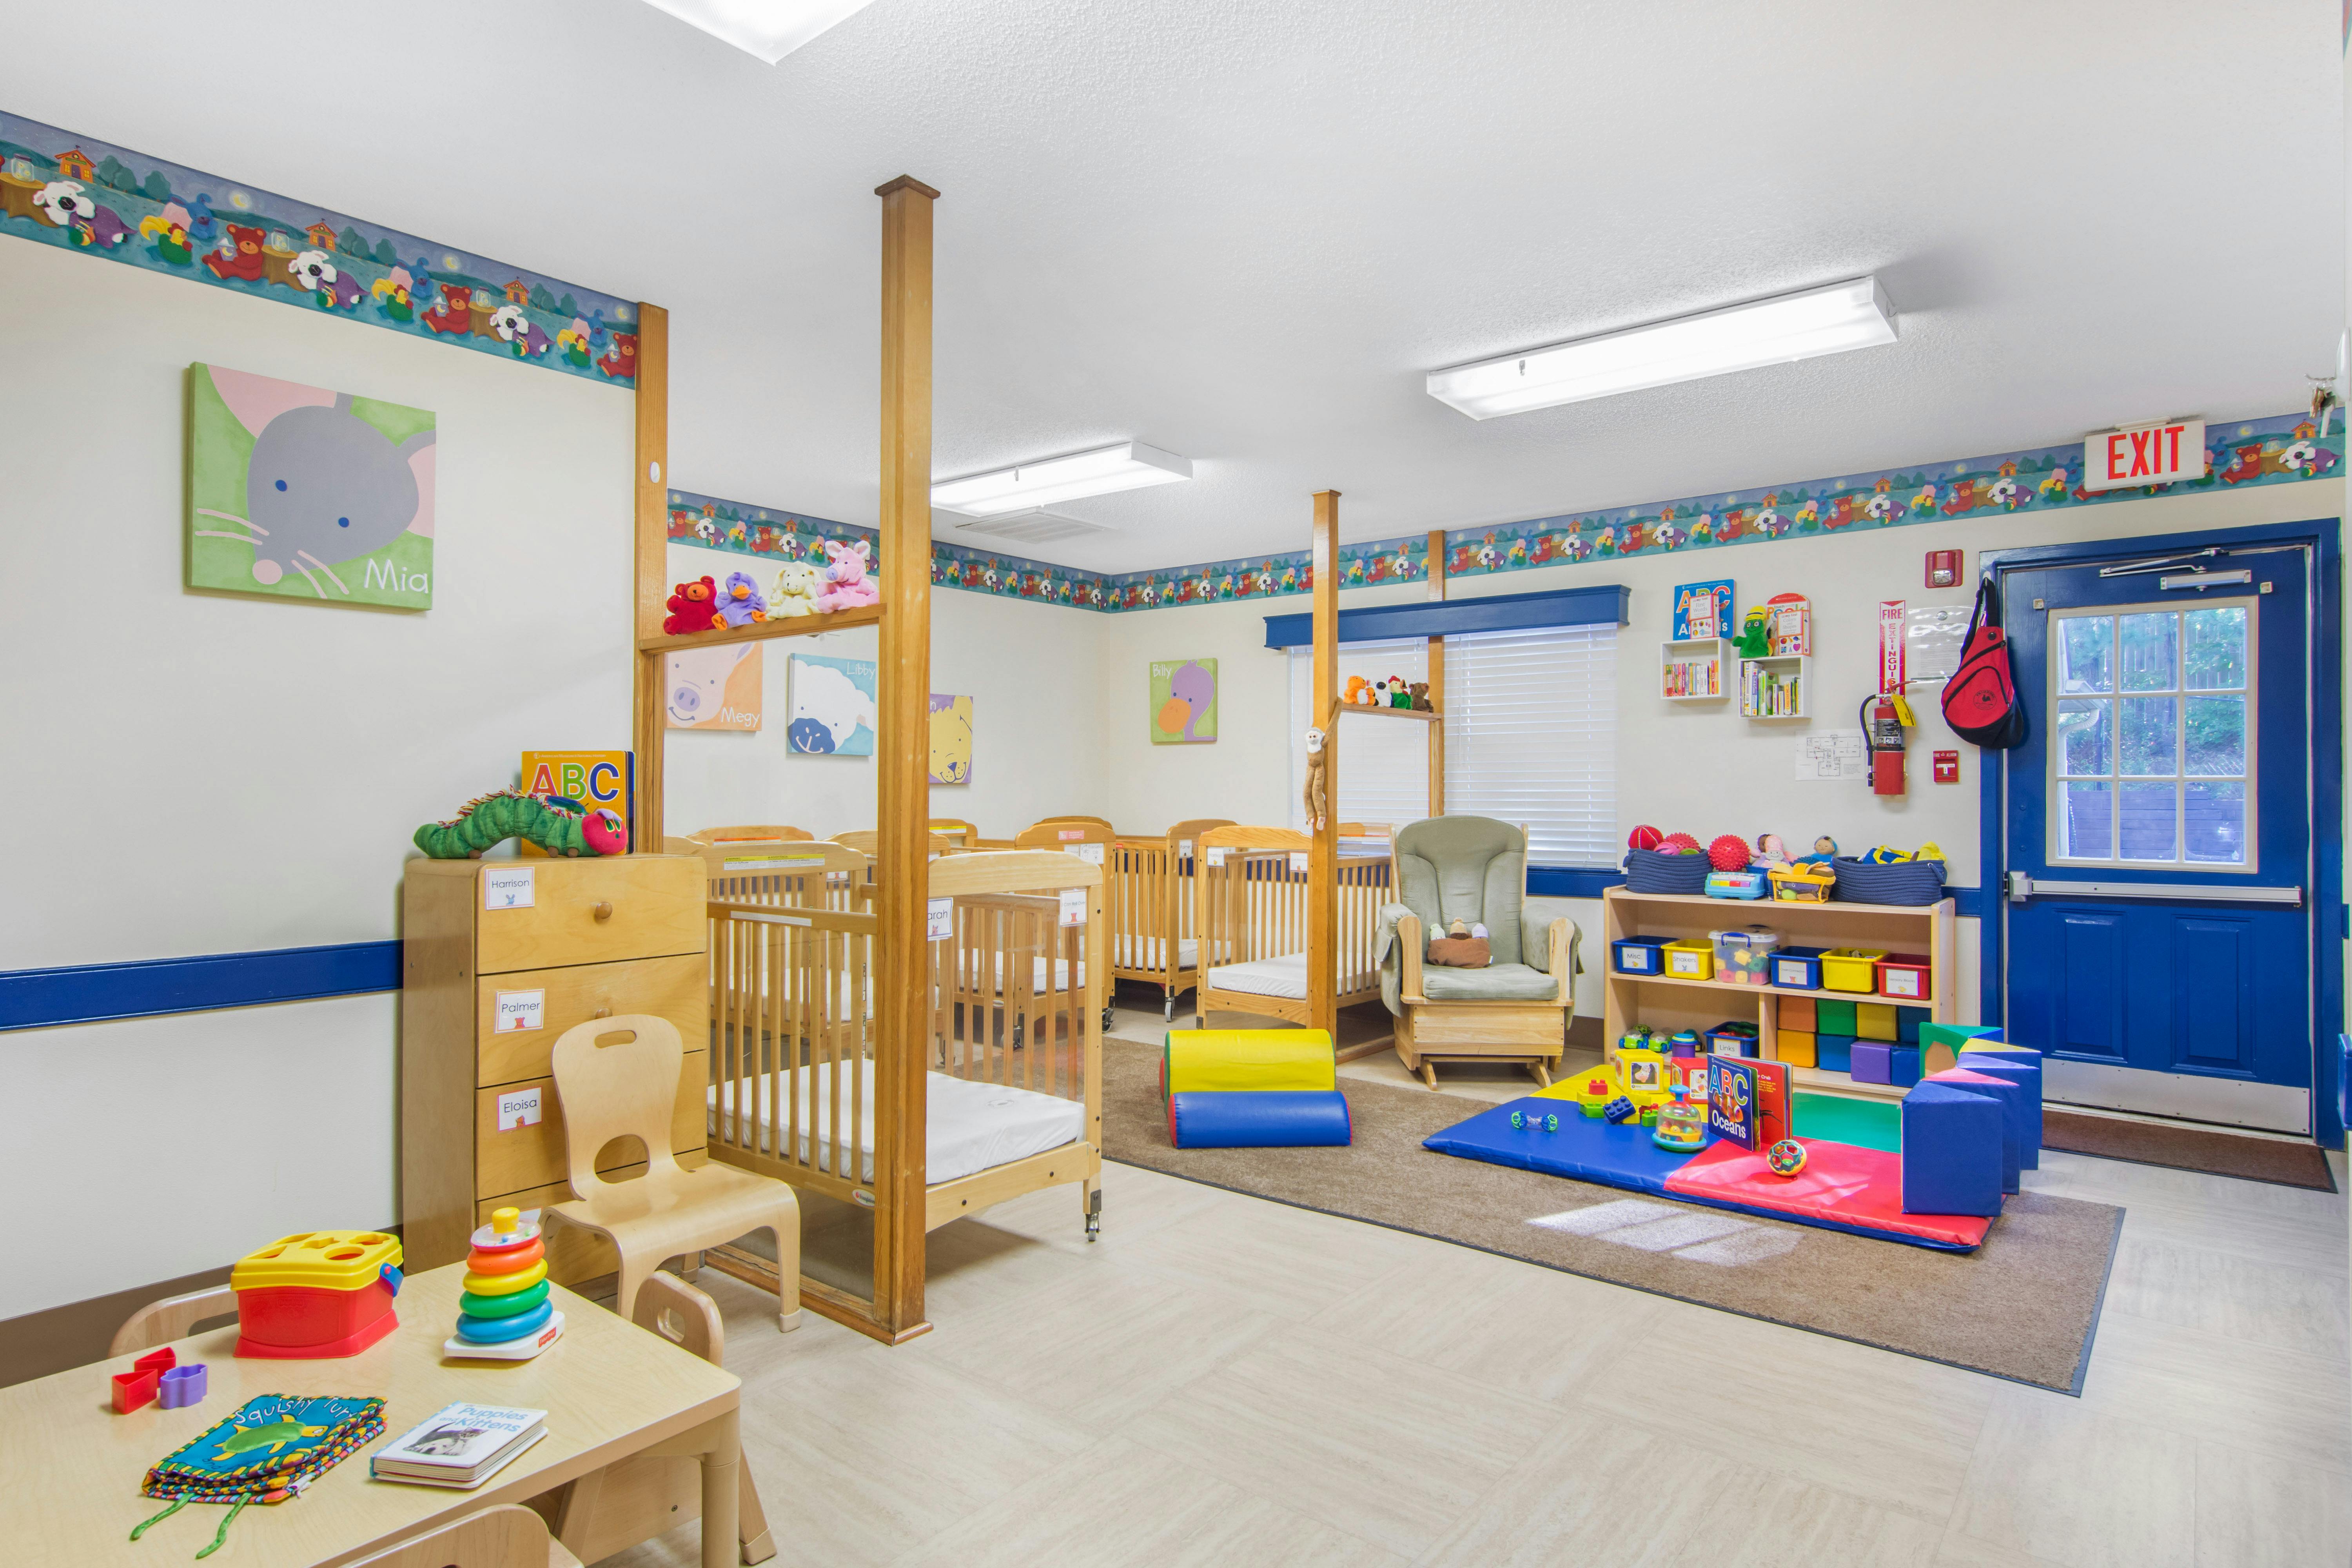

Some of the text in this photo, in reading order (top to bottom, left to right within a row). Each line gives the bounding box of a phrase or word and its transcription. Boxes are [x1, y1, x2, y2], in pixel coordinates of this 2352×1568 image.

[2108, 426, 2184, 480] EXIT
[364, 558, 428, 593] Mia
[1882, 608, 1903, 620] FIRE
[1888, 623, 1897, 685] EXTINGUIS
[846, 662, 875, 680] Libby
[1153, 664, 1172, 679] Billy
[720, 706, 760, 728] Megy
[530, 762, 620, 802] ABC
[492, 880, 529, 888] Harrison
[928, 909, 947, 920] arah
[502, 1002, 541, 1013] Palmer
[1708, 1065, 1748, 1106] ABC
[504, 1099, 537, 1113] Eloisa
[1712, 1109, 1746, 1139] Oceans
[235, 1397, 318, 1425] Squishy
[458, 1407, 528, 1420] Puppies
[455, 1417, 521, 1432] Kittens
